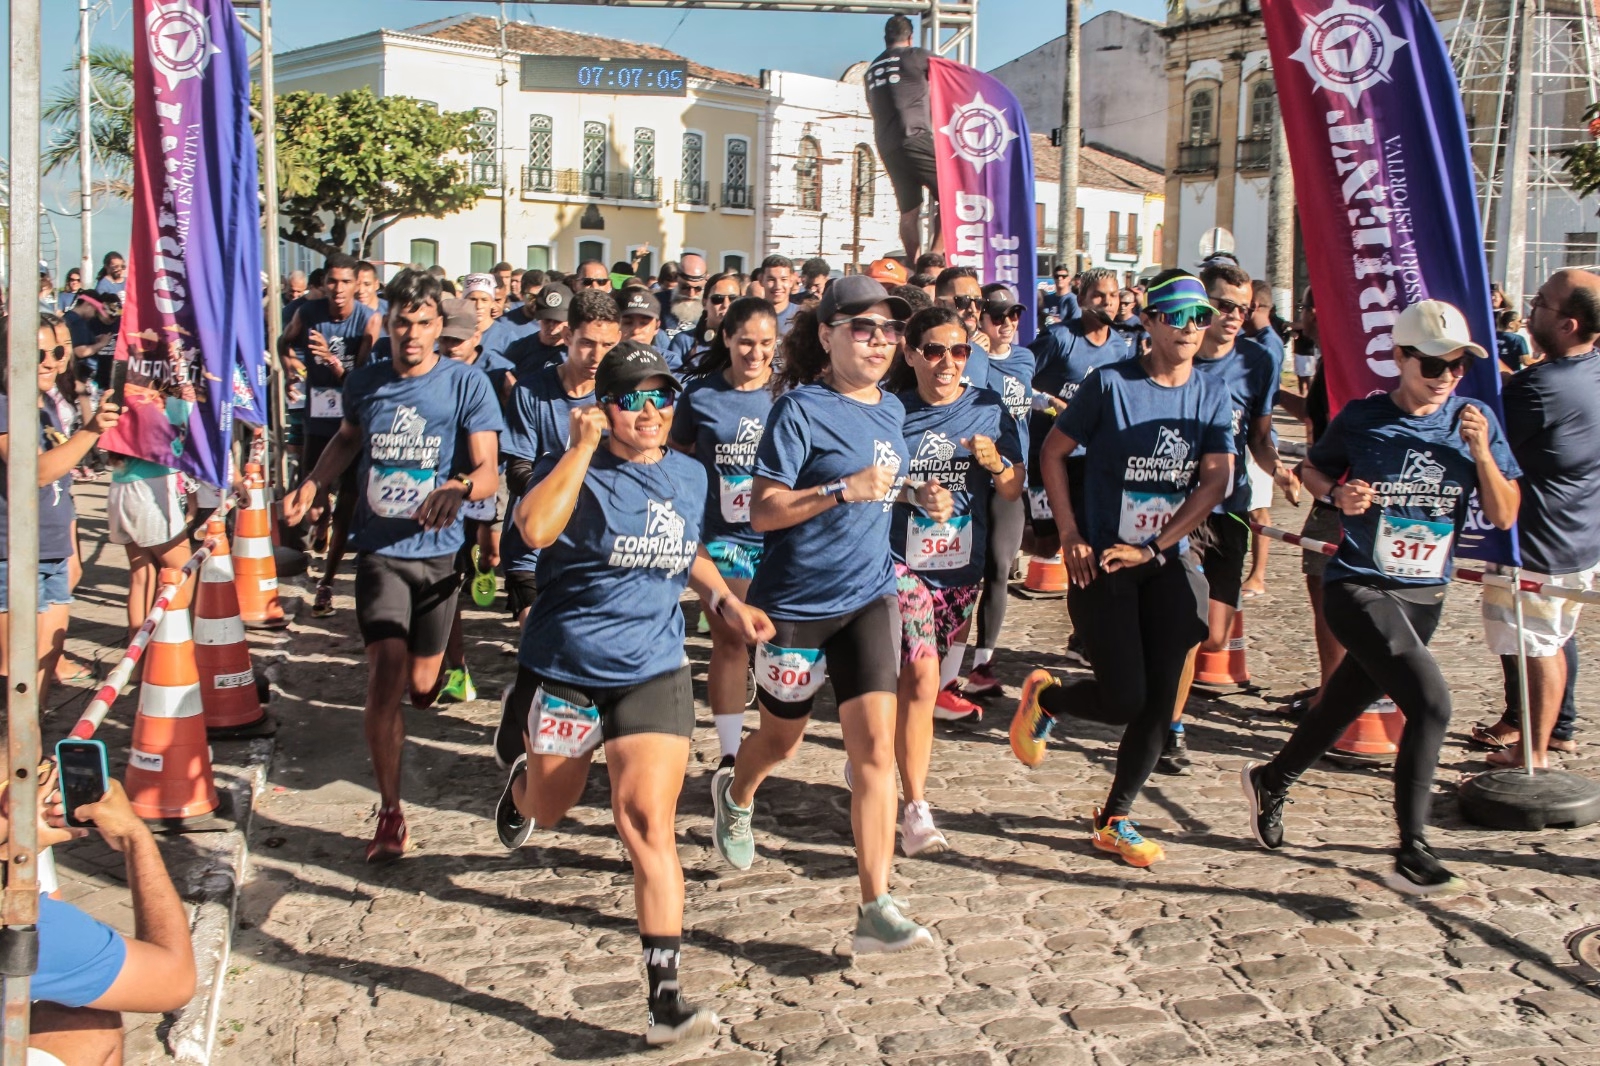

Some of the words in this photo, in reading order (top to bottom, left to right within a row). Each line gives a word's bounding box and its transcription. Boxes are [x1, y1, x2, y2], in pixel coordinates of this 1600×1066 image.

[578, 66, 683, 89] 07:07:05
[177, 123, 201, 206] ESPORTIVA
[1384, 134, 1415, 234] ESPORTIVA
[950, 190, 994, 285] ing
[1325, 109, 1402, 378] ORIENT
[370, 433, 424, 448] CORRIDA
[425, 435, 442, 448] DO
[954, 461, 970, 471] DO
[1127, 456, 1184, 470] CORRIDA
[1124, 468, 1158, 482] BOM
[381, 485, 419, 502] 222
[1371, 481, 1440, 495] CORRIDA
[1442, 485, 1463, 496] DO
[1371, 494, 1407, 508] BOM
[1406, 495, 1456, 508] JESUS
[613, 535, 683, 556] CORRIDA
[684, 540, 698, 555] DO
[921, 537, 961, 554] 364
[1391, 539, 1437, 561] 317
[608, 551, 651, 570] BOM
[767, 664, 811, 686] 300
[540, 717, 592, 741] 287
